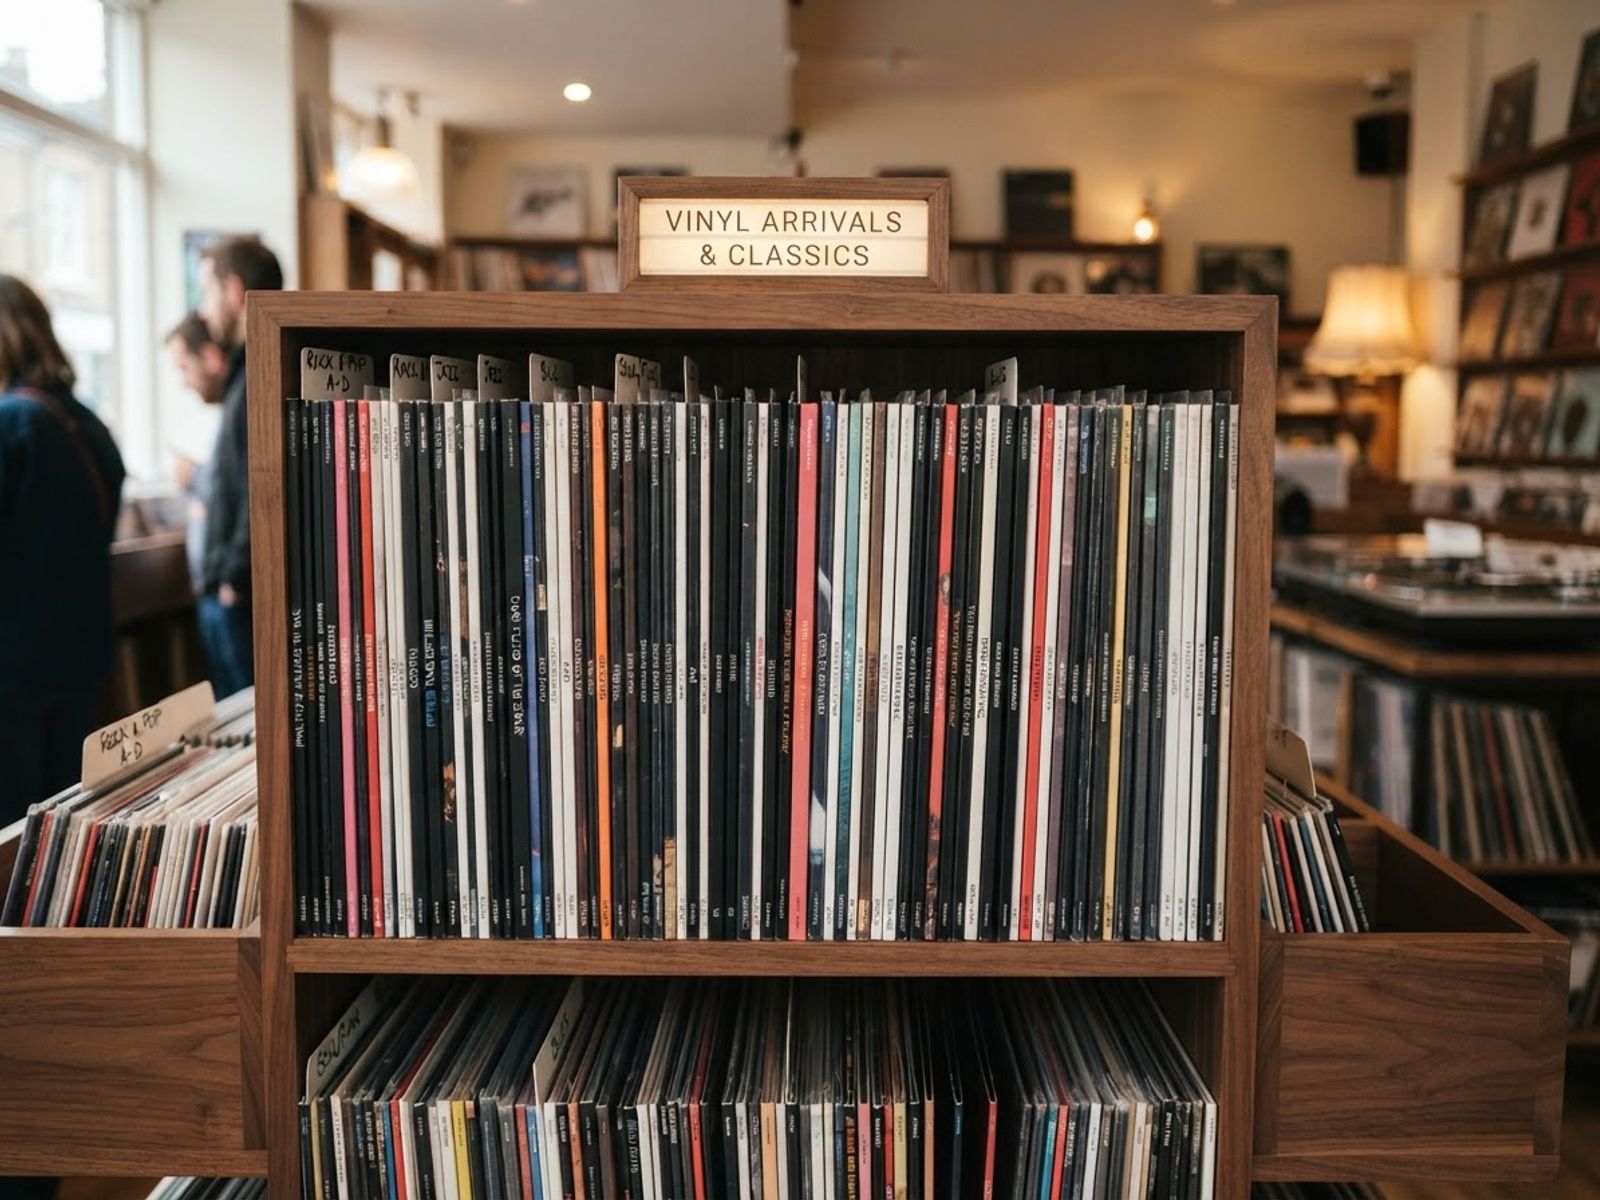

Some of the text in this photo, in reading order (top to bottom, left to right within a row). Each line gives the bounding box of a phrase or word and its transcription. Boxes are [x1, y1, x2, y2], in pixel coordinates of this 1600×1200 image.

[665, 210, 903, 233] VINYL ARRIVALS
[700, 243, 870, 267] & CLASSICS
